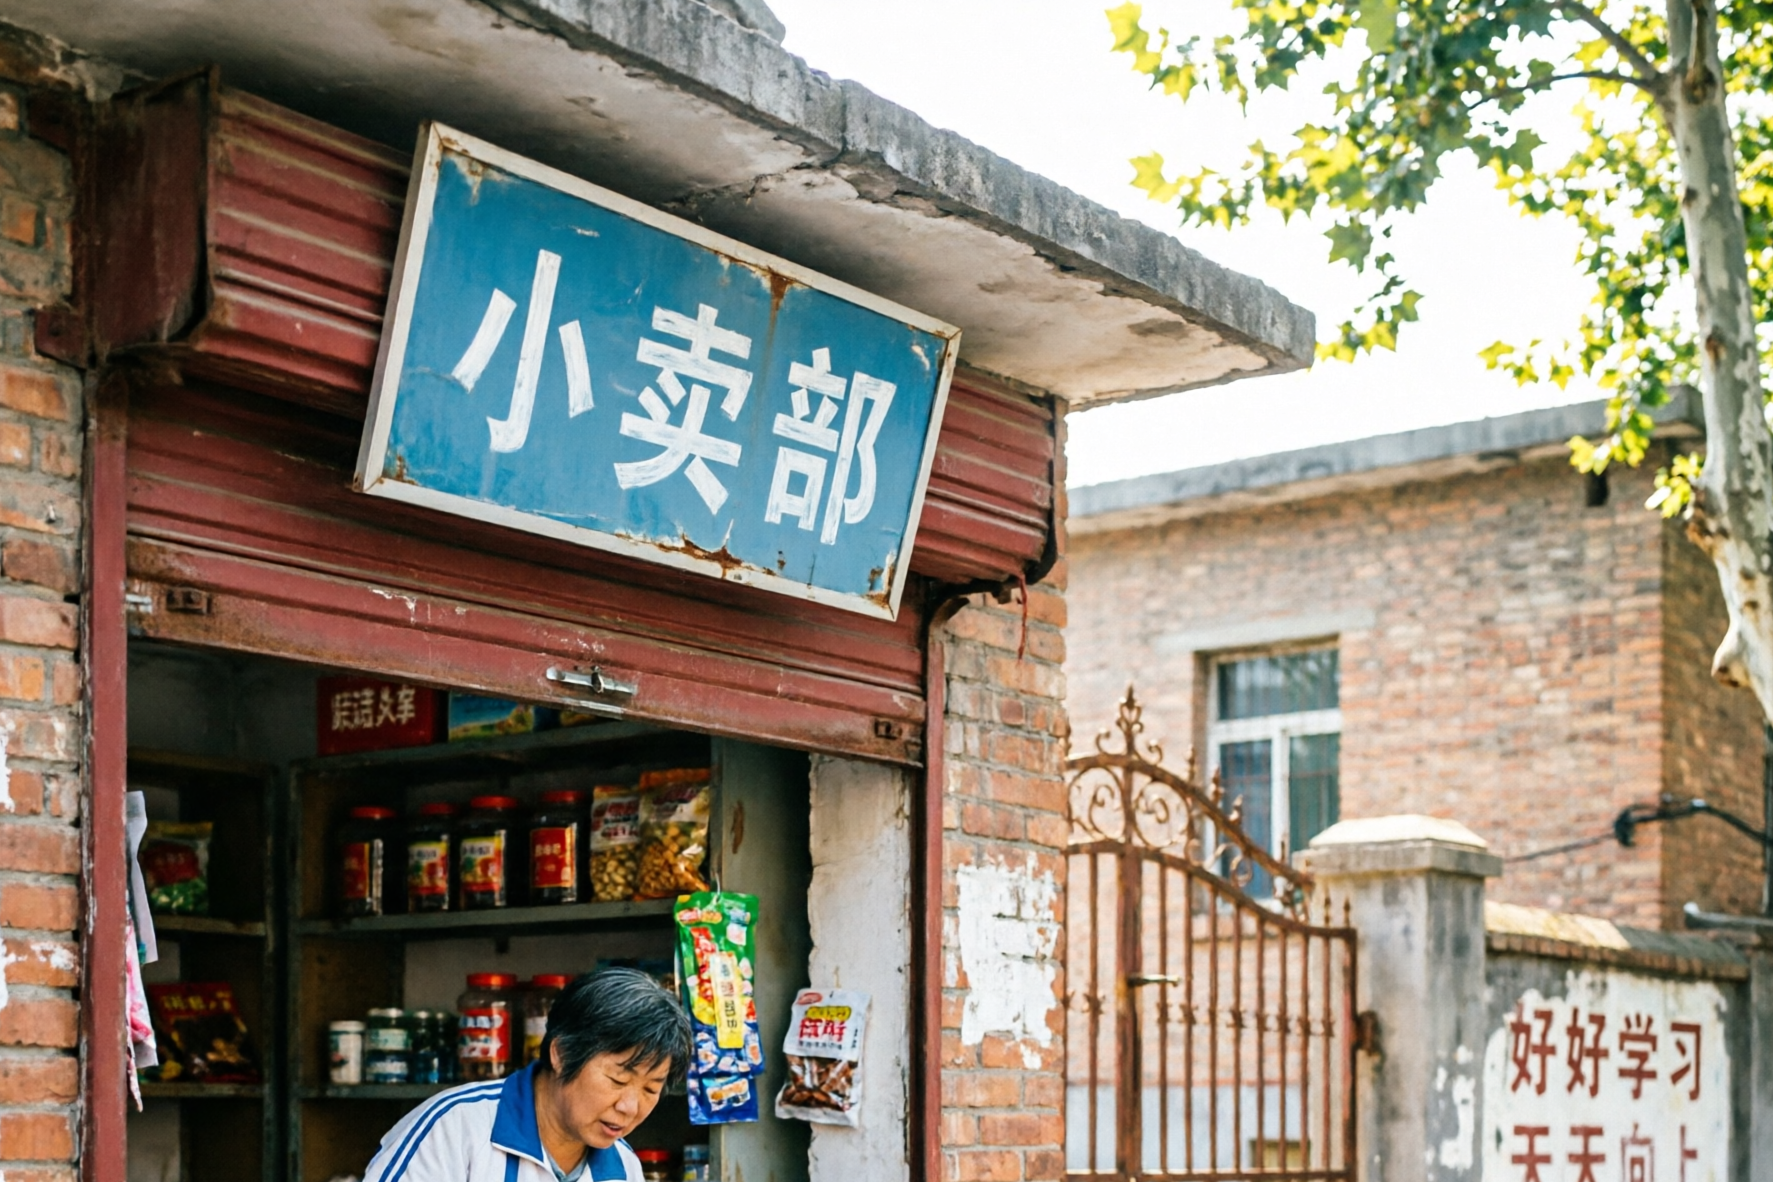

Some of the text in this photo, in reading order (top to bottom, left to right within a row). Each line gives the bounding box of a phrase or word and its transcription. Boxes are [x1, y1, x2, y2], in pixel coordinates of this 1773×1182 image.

[451, 248, 897, 545] 小卖部
[1510, 1000, 1702, 1101] 好好学习
